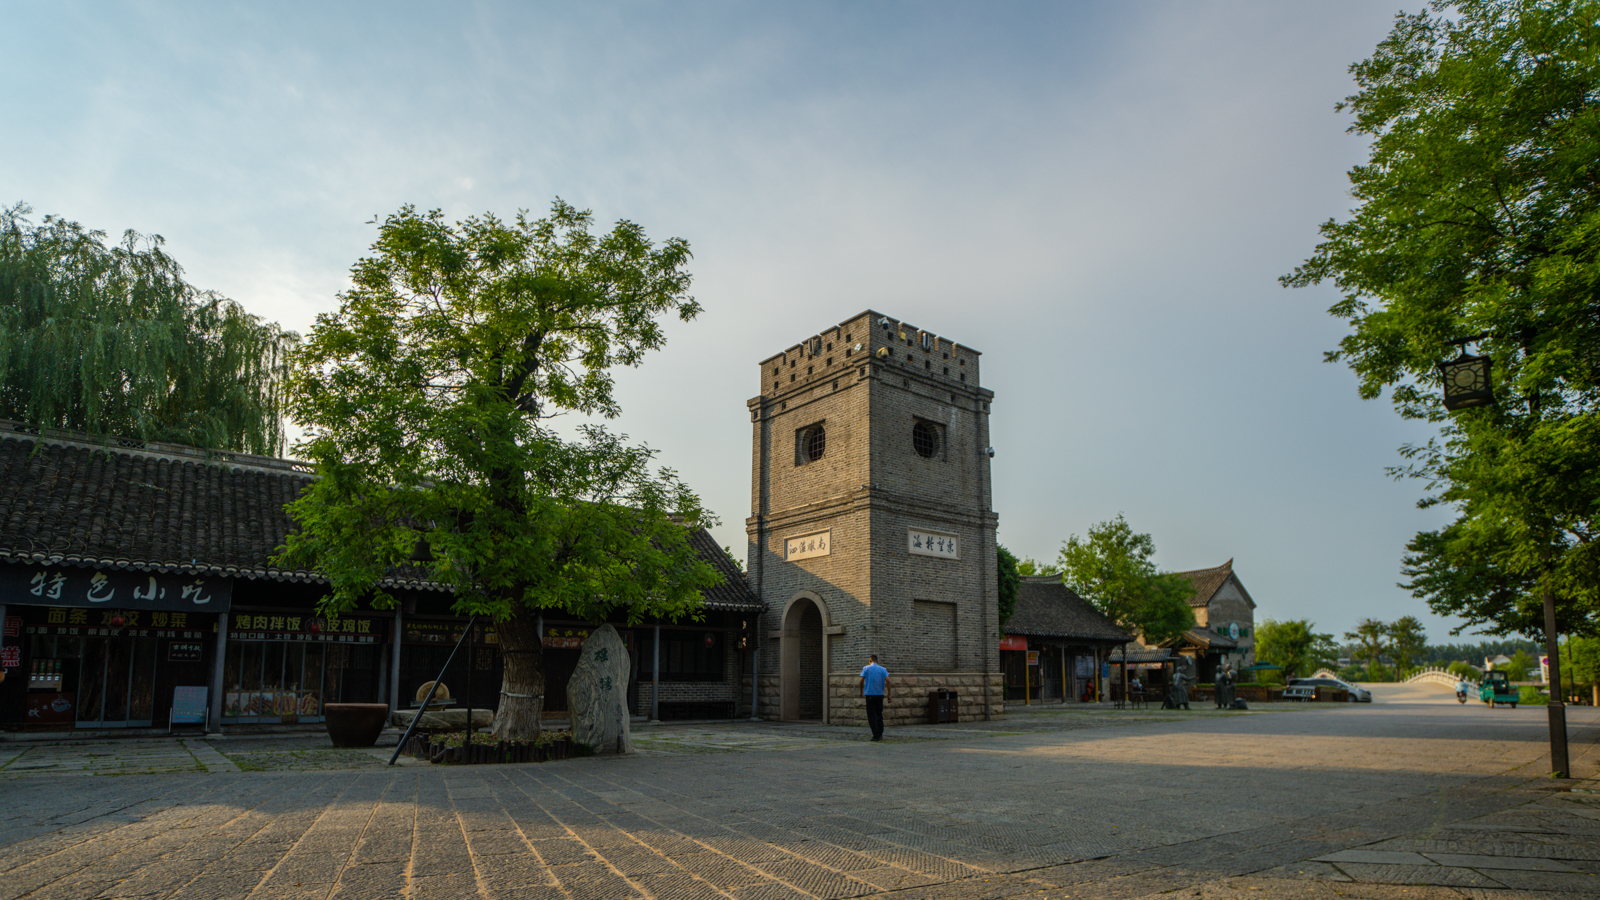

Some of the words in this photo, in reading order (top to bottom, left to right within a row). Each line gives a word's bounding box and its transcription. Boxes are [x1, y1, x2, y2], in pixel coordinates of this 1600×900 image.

[30, 571, 211, 604] 特色小吃
[47, 608, 88, 624] 面条
[151, 611, 188, 628] 炒菜
[235, 614, 301, 631] 烤肉拌饭
